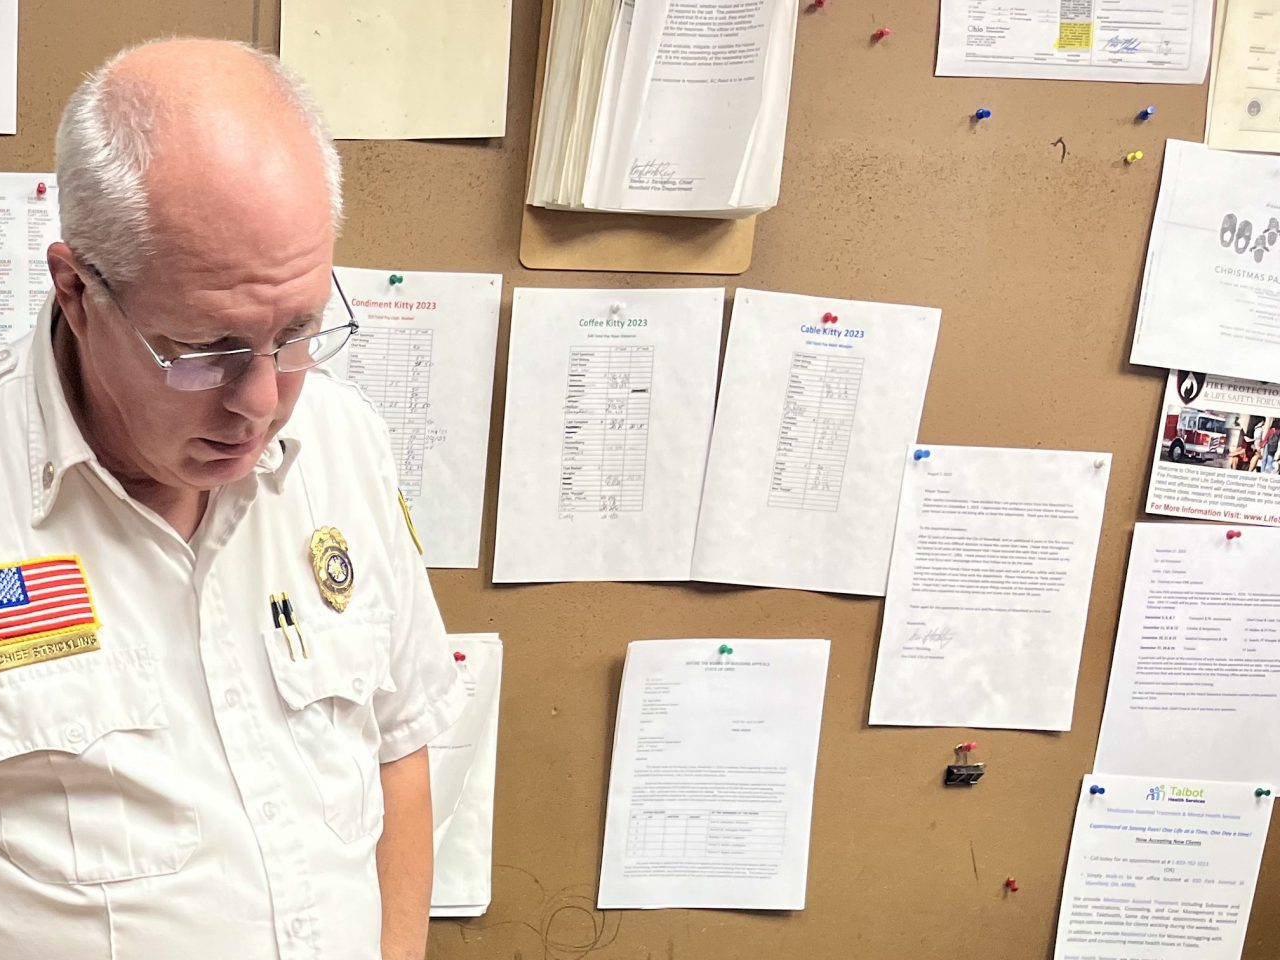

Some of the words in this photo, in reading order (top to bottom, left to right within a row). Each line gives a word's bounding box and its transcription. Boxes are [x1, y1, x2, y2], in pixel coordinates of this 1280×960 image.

[351, 298, 392, 309] Condiment
[394, 299, 414, 311] Kitty
[415, 301, 437, 311] 2023
[579, 318, 604, 327] Coffee
[606, 319, 626, 329] Kitty
[627, 319, 648, 327] 2023
[800, 325, 821, 335] Cable
[822, 327, 842, 338] Kitty
[843, 329, 865, 338] 2023
[1205, 381, 1224, 389] FIRE
[1227, 383, 1280, 397] PROTECTIO
[1150, 502, 1162, 510] For
[1163, 504, 1180, 512] More
[1181, 504, 1221, 517] Information
[1223, 510, 1241, 519] Visit:
[1169, 787, 1205, 798] Talbot
